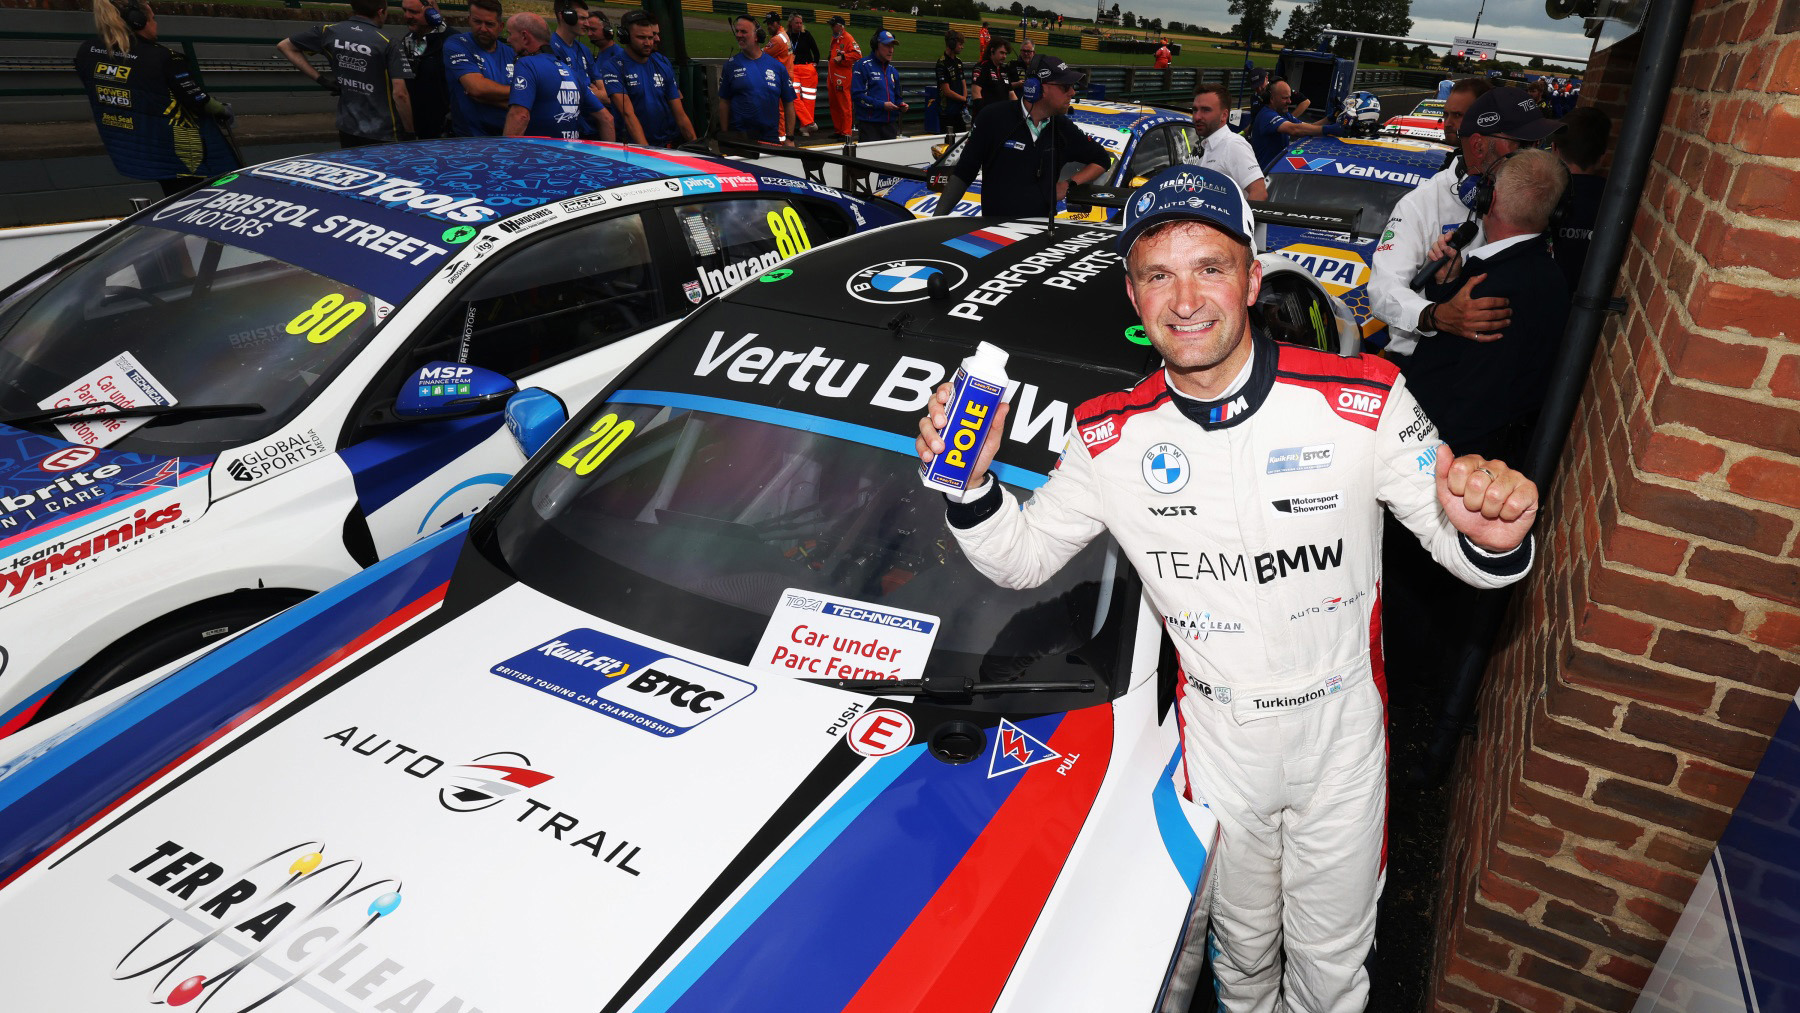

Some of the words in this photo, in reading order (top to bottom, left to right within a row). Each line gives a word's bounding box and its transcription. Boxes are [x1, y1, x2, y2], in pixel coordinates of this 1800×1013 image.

[90, 45, 107, 55] Evans
[334, 38, 372, 57] LKQ
[96, 63, 132, 79] PMR
[97, 86, 129, 98] POWER
[118, 115, 133, 125] Seal
[271, 161, 364, 188] DRAPER
[1335, 162, 1433, 186] Valvoli
[359, 177, 495, 223] Tools
[1158, 200, 1186, 211] AUTO
[1205, 204, 1231, 216] TRAIL
[178, 208, 274, 237] MOTORS
[203, 192, 319, 228] BRISTOL
[311, 215, 449, 267] STREET
[1286, 213, 1343, 223] PARTS
[766, 206, 812, 261] 80
[447, 258, 472, 284] GRIDSHARK
[697, 250, 781, 296] Ingram
[947, 230, 1118, 322] PERFORMANCE
[1043, 249, 1124, 291] PARTS
[285, 293, 367, 344] 80
[464, 306, 477, 343] MOTORS
[128, 370, 165, 406] TECHNICAL
[418, 366, 473, 381] MSP
[73, 383, 93, 406] Parc
[96, 375, 115, 394] Car
[108, 387, 136, 410] unde
[693, 330, 870, 398] Vertu
[869, 356, 1076, 454] BW
[1338, 393, 1382, 414] OMP
[306, 428, 327, 453] MEDIA
[556, 413, 636, 476] 20
[944, 399, 990, 470] POLE
[1083, 420, 1116, 443] OMP
[47, 449, 91, 468] E
[242, 433, 310, 466] GLOBAL
[251, 444, 318, 480] SPORTS
[1146, 445, 1183, 461] BMW
[1302, 449, 1331, 462] BTCC
[0, 464, 122, 515] brite
[44, 485, 105, 513] CARE
[1291, 493, 1339, 506] Motorsport
[1148, 505, 1198, 517] WSR
[1292, 502, 1338, 514] Showroom
[116, 517, 191, 554] WHEELS
[10, 541, 65, 570] team
[1146, 551, 1248, 582] TEAM
[1254, 537, 1343, 585] BMW
[33, 556, 101, 589] ALLOY
[832, 603, 924, 632] TECHNICAL
[1290, 606, 1320, 621] AUTO
[1342, 590, 1366, 607] TRAIL
[790, 624, 827, 648] Car
[832, 634, 902, 664] under
[770, 645, 819, 674] Parc
[495, 664, 533, 683] BRITISH
[533, 677, 576, 699] TOURING
[576, 693, 598, 706] CAR
[597, 702, 676, 736] CHAMPIONSHIP
[626, 668, 725, 714] BTCC
[1253, 688, 1326, 709] Turkington
[825, 701, 864, 737] PUSH
[859, 715, 903, 750] E
[1056, 750, 1081, 777] PULL
[323, 725, 445, 779] AUTO
[516, 798, 642, 877] TRAIL
